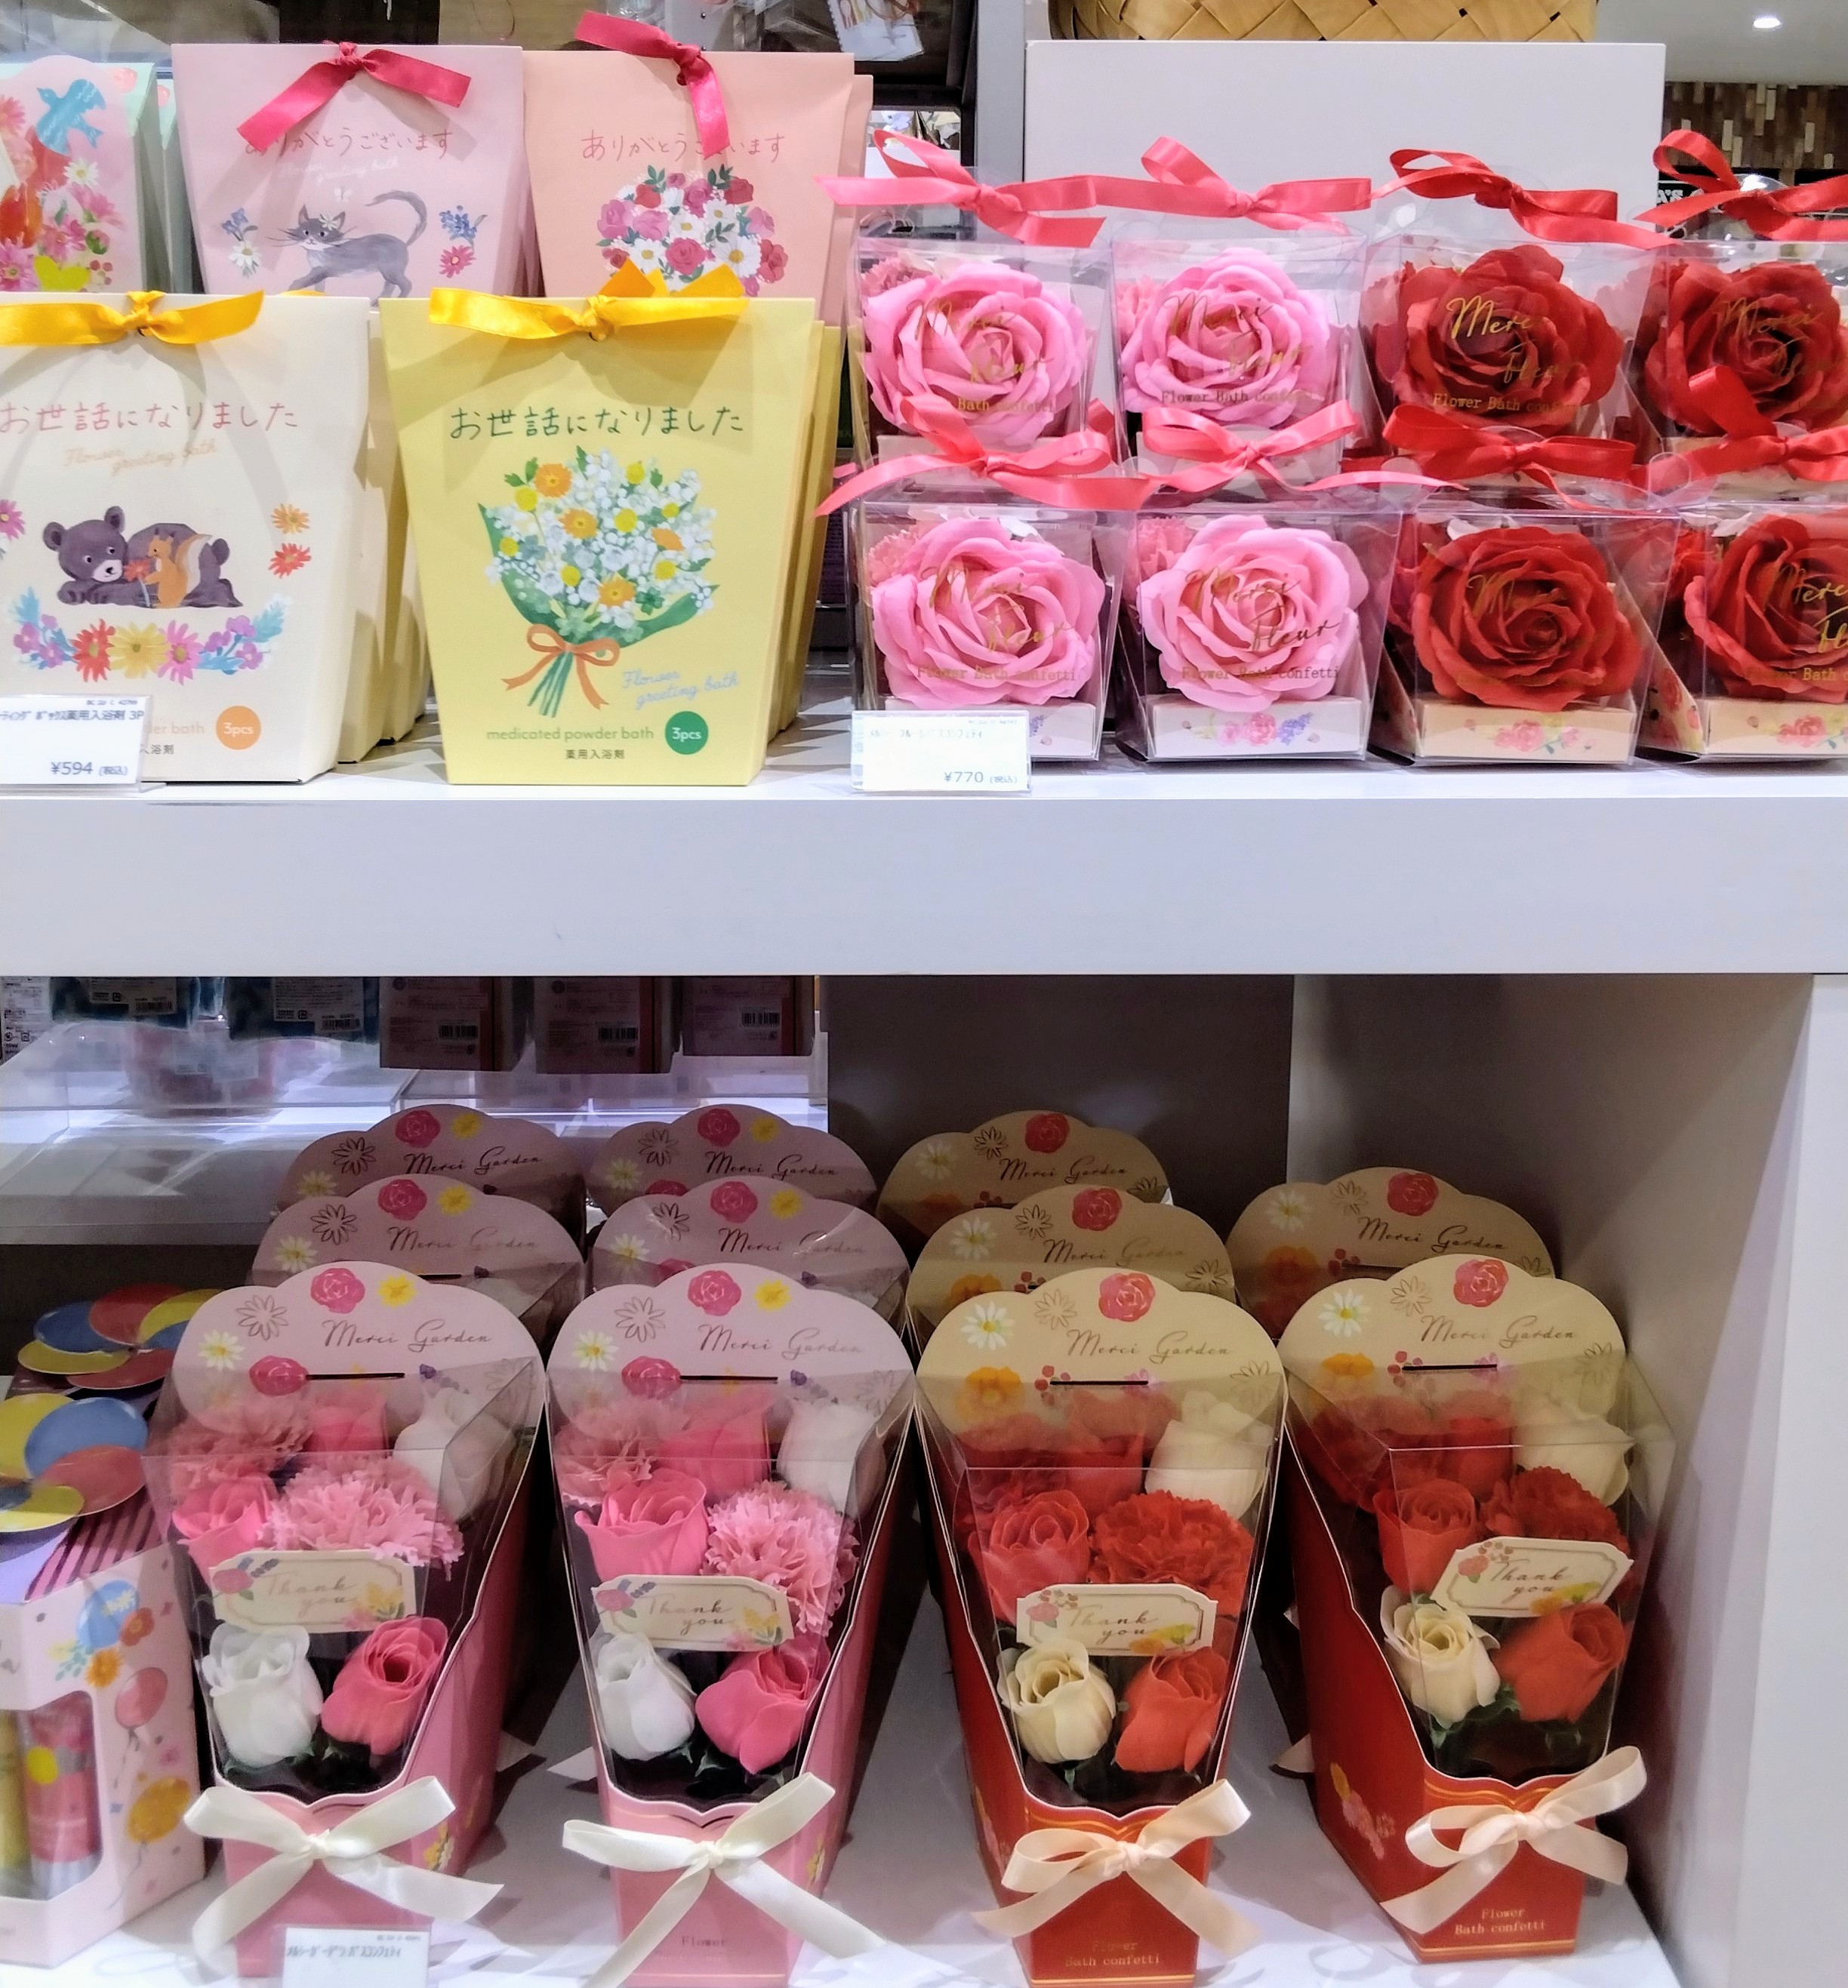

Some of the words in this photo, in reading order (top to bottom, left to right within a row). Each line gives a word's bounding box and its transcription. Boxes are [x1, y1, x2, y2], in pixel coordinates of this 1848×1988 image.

[245, 127, 452, 160] りがとうございます
[581, 129, 784, 163] ありがとういます
[957, 397, 990, 412] Bath
[1434, 394, 1481, 408] Flower
[1487, 397, 1520, 411] Bath
[0, 402, 298, 432] お世話になりました
[450, 405, 744, 440] お世話になりました
[621, 669, 679, 688] Flower
[1279, 666, 1340, 680] confetti
[1802, 667, 1836, 681] Bath
[636, 685, 698, 711] greeting
[704, 671, 739, 691] bath
[171, 718, 205, 735] bath
[222, 722, 254, 736] 3pcs
[486, 726, 561, 740] medicated
[565, 728, 618, 744] powder
[621, 726, 654, 740] bath
[671, 726, 702, 743] 3pcs
[51, 761, 94, 776] ¥594
[944, 771, 984, 783] ¥770
[404, 1152, 467, 1175] Merci
[474, 1146, 544, 1175] Garden
[705, 1151, 764, 1175] Merci
[772, 1153, 839, 1180] Garden
[999, 1157, 1056, 1181] Merci
[1064, 1155, 1128, 1184] Garden
[387, 1226, 456, 1251] Merci
[718, 1227, 781, 1253] Merci
[1358, 1217, 1421, 1243] Merci
[1431, 1224, 1508, 1254] Garden
[1043, 1238, 1107, 1264] Merci
[322, 1319, 398, 1348] Merci
[408, 1319, 492, 1353] Garden
[698, 1324, 772, 1353] Merci
[782, 1327, 865, 1361] Garden
[1421, 1315, 1490, 1343] Merci
[1499, 1315, 1577, 1349] Garden
[1066, 1328, 1139, 1357] Merci
[1149, 1330, 1232, 1365] Garden
[1490, 1558, 1570, 1583] Thank
[640, 1592, 732, 1616] Thank
[1501, 1583, 1560, 1605] you
[679, 1617, 736, 1636] you
[1069, 1604, 1160, 1628] Thank
[1095, 1626, 1155, 1646] you
[1481, 1906, 1525, 1920] Flower
[1455, 1923, 1486, 1936] Bath
[1490, 1919, 1546, 1933] confetti
[1064, 1955, 1096, 1967] Bath
[1102, 1953, 1161, 1966] confetti
